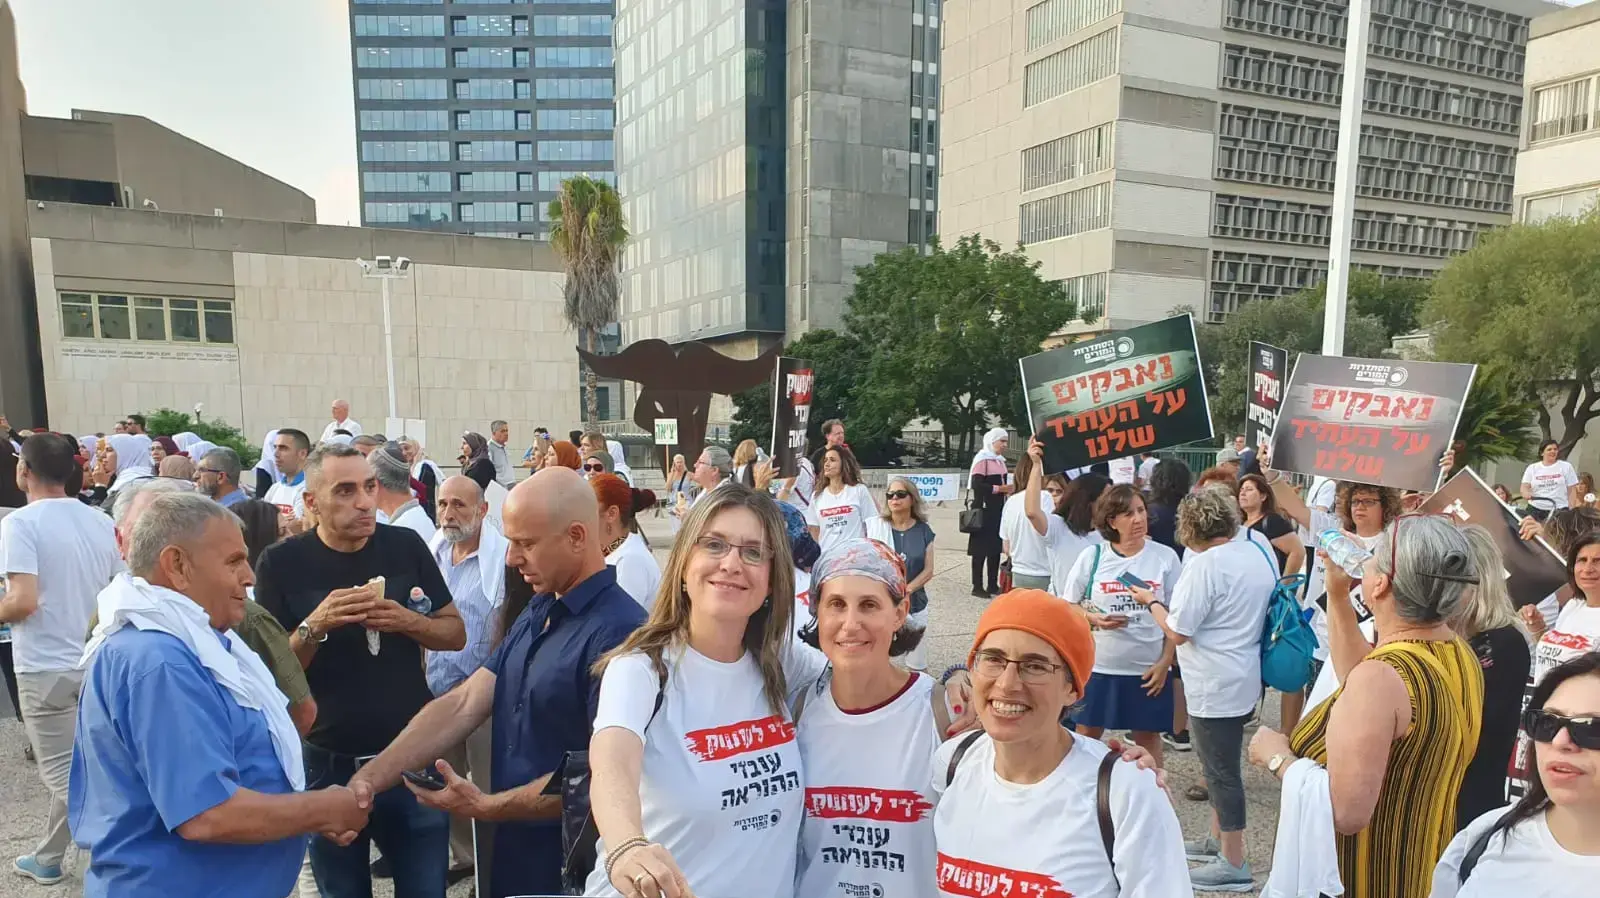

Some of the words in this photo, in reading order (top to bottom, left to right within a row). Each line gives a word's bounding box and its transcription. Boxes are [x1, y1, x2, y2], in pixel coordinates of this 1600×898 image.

[1073, 340, 1115, 356] הסתדרות
[1084, 346, 1116, 359] המורים
[1052, 354, 1174, 404] נאבקים
[1348, 363, 1392, 373] הסתדרות
[1356, 370, 1389, 379] המורים
[1145, 388, 1187, 416] על
[1311, 388, 1436, 420] נאבקים
[1046, 400, 1140, 438] העתיד
[1085, 424, 1156, 458] שלנו
[1291, 418, 1386, 447] העתיד
[1389, 425, 1431, 456] על
[1314, 448, 1385, 477] שלנו
[730, 752, 782, 779] עובדי
[721, 771, 800, 811] ההוראה
[889, 798, 915, 817] די
[733, 814, 769, 827] הסתדרות
[741, 820, 768, 831] המורים
[833, 824, 890, 848] עובדי
[821, 847, 905, 872] ההוראה
[838, 882, 870, 891] הסתדרות
[845, 888, 870, 897] המורים
